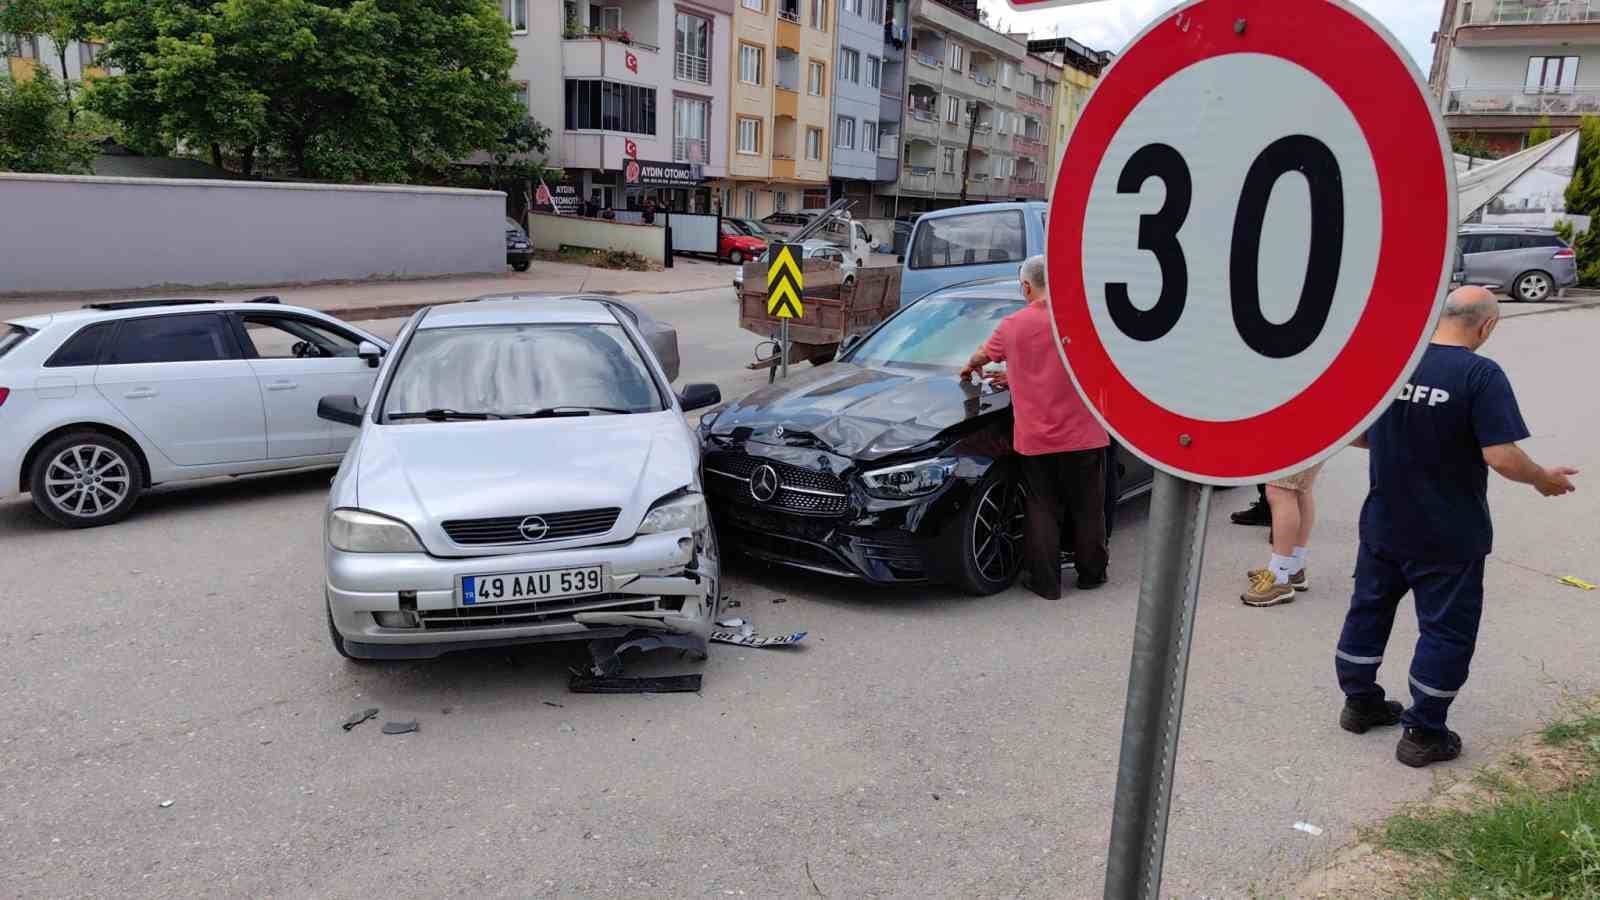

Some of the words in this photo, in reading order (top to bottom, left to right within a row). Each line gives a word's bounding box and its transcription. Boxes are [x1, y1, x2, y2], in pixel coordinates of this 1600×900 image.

[641, 167, 663, 177] AYDIN
[1105, 134, 1344, 358] 30
[478, 578, 504, 599] 49
[512, 574, 551, 597] AAU
[560, 570, 599, 593] 539
